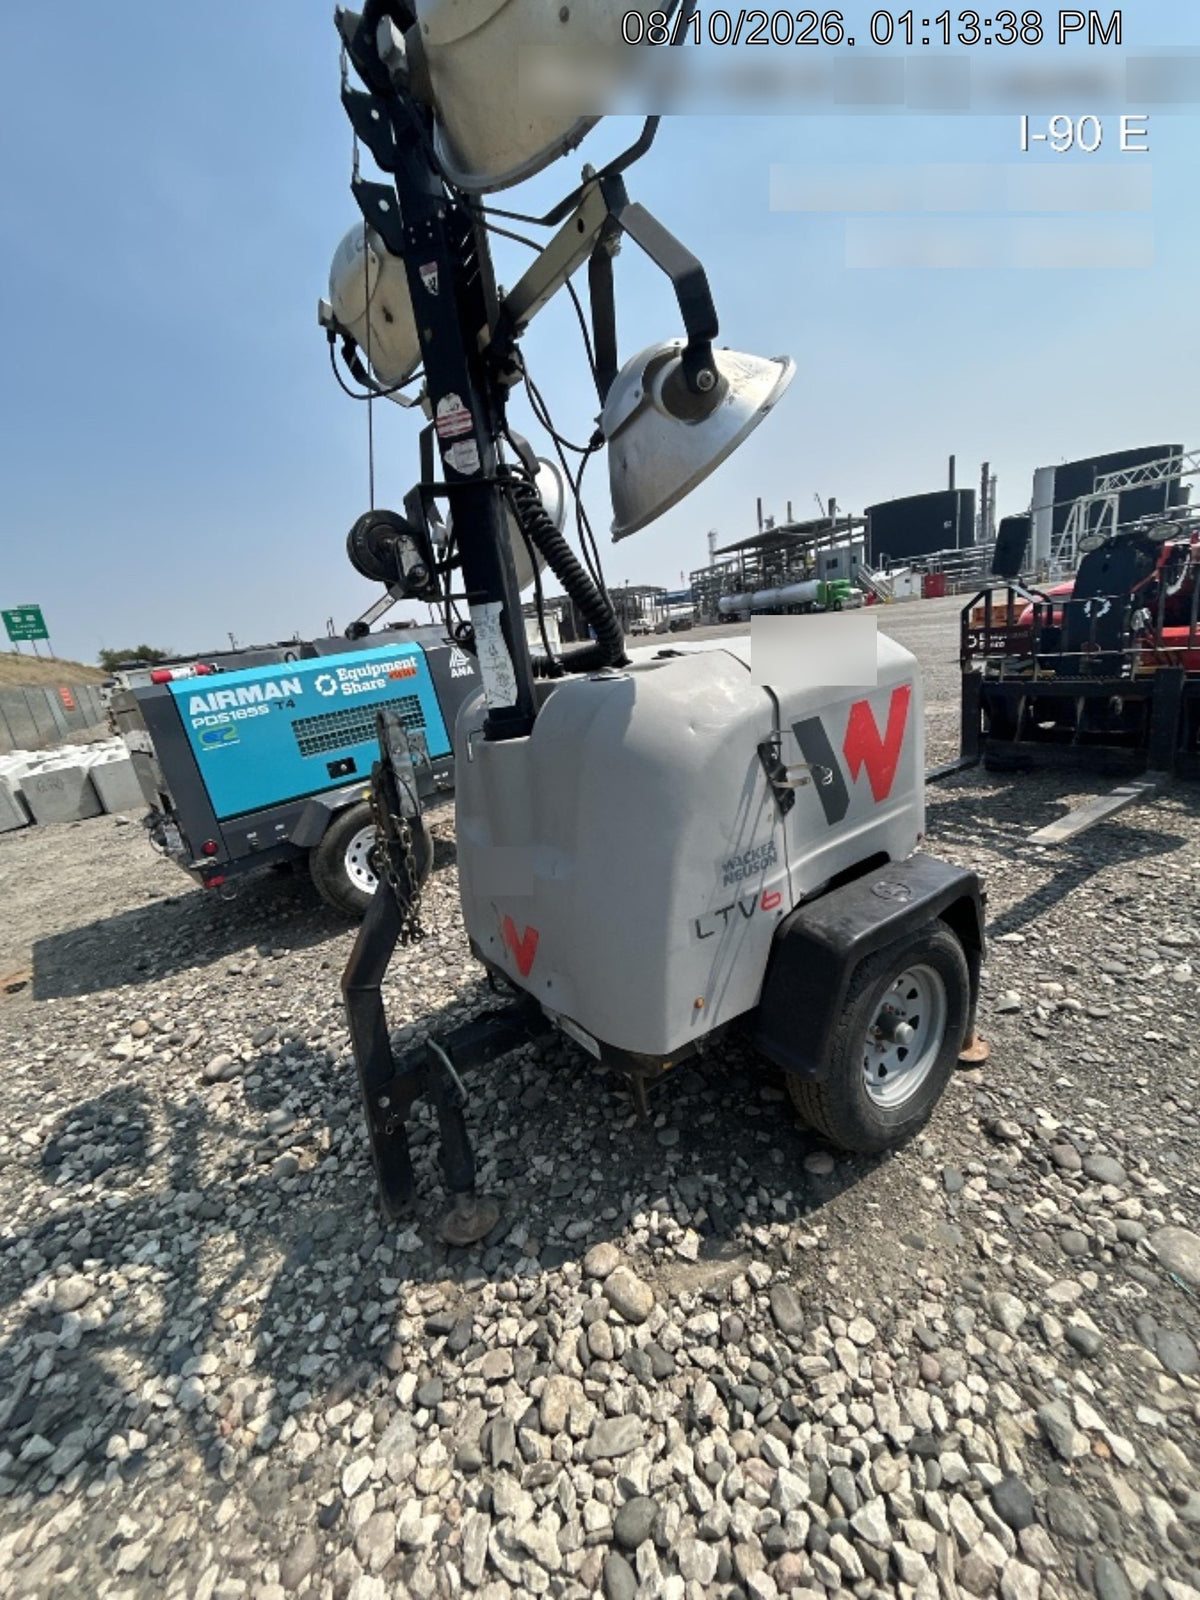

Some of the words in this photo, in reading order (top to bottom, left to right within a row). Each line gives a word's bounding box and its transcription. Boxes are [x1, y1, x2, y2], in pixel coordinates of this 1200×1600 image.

[335, 655, 417, 682] Equipment
[451, 664, 475, 679] ANA
[189, 677, 303, 715] AIRMAN
[340, 678, 387, 696] Share
[722, 840, 777, 873] WACKER
[723, 850, 778, 888] NEUSON
[695, 890, 782, 940] LTV6
